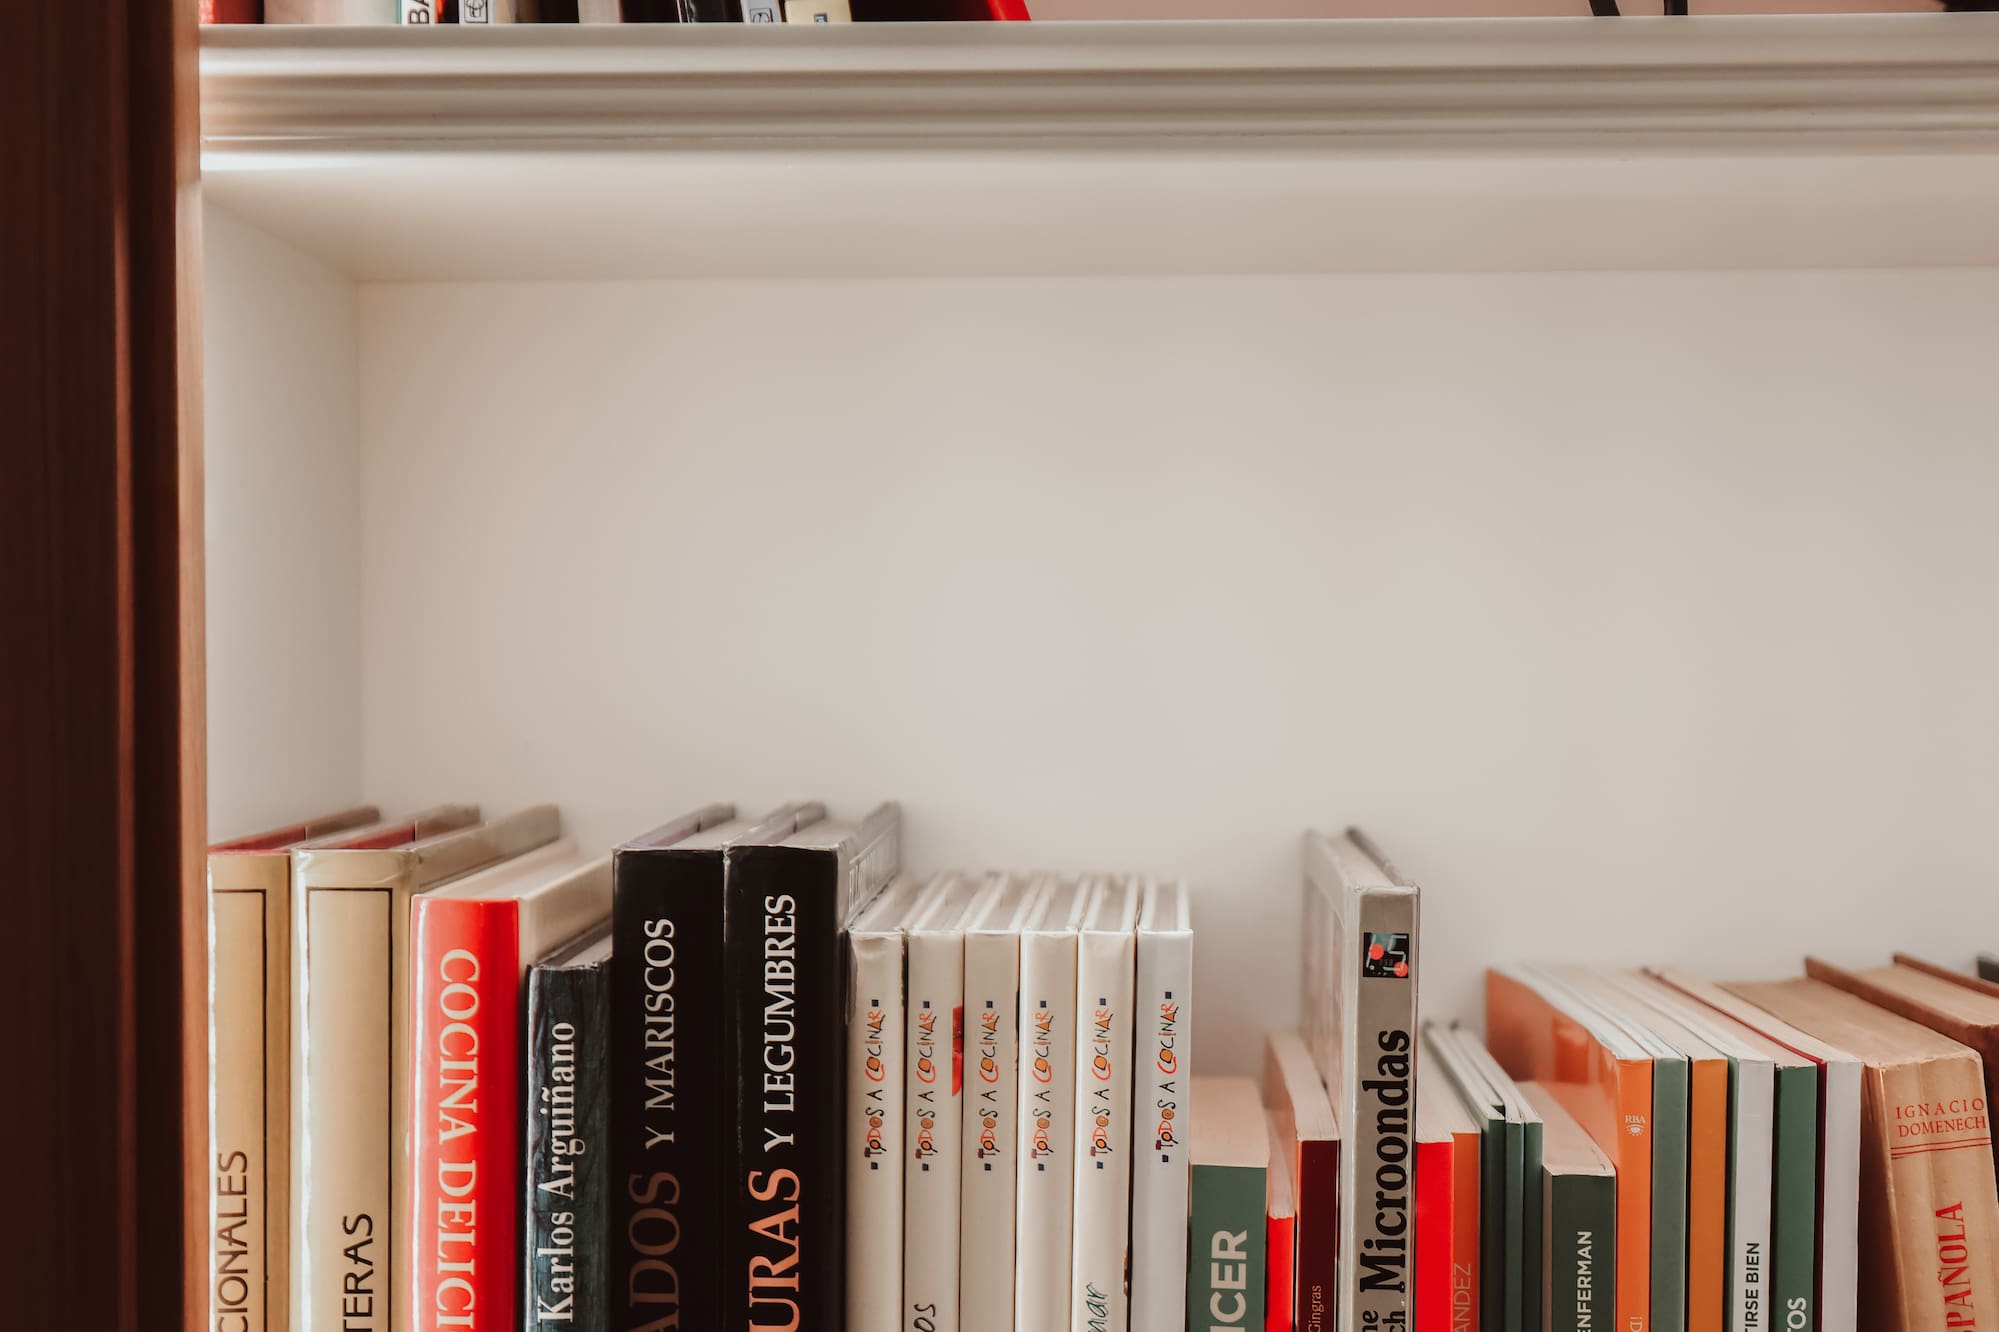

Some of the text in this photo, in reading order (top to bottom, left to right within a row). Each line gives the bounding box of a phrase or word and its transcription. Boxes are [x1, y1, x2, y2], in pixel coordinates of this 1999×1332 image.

[644, 917, 675, 1111] MARISCOS
[864, 1010, 885, 1082] COCINAR
[916, 1011, 937, 1084] COCINAR
[979, 1010, 1000, 1083] COCINAR
[1032, 1010, 1054, 1083] COCINAR
[1091, 1008, 1114, 1080] COCINAR
[1157, 1002, 1179, 1075] COCINAR
[748, 894, 801, 1332] URAS Y LEGUMBRES
[866, 1089, 883, 1101] A
[918, 1090, 935, 1102] A
[981, 1090, 997, 1102] A
[1034, 1090, 1051, 1102] A
[1093, 1088, 1110, 1100] A
[1158, 1081, 1175, 1093] A
[1896, 1097, 1985, 1120] IGNACIO
[435, 949, 480, 1329] COCINA DELICI
[644, 1125, 675, 1151] Y
[1359, 1029, 1410, 1294] Microondas
[1898, 1115, 1987, 1138] DOMENECH
[536, 1022, 586, 1323] Karlos Arguiñano
[216, 1150, 249, 1332] CIONALES
[342, 1213, 374, 1332] TERAS
[1745, 1242, 1760, 1283] BIEN
[1935, 1201, 1976, 1332] PAÑOLA
[1210, 1230, 1248, 1332] CER
[1786, 1297, 1807, 1332] OS
